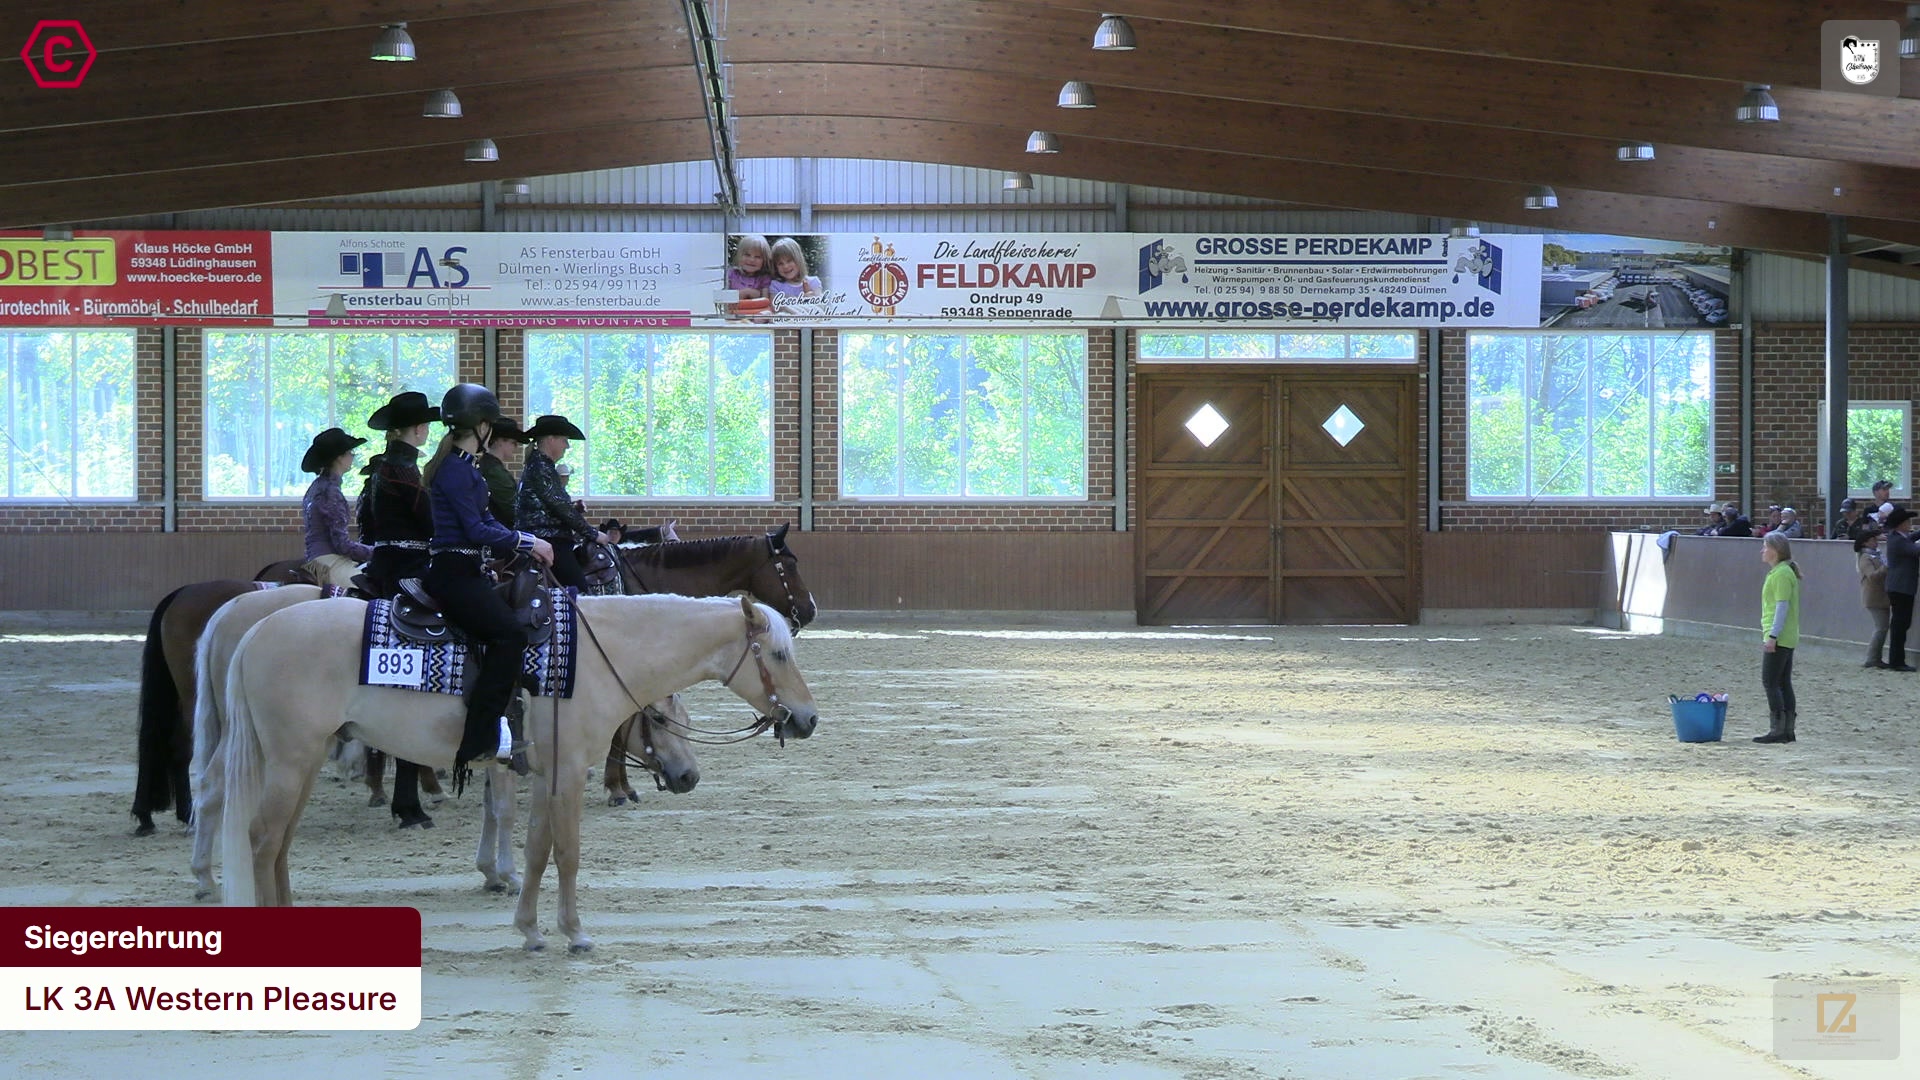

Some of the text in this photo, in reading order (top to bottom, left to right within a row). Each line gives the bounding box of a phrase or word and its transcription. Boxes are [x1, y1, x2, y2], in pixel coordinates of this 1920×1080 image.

[134, 242, 252, 254] Klaus Höcke GmbH
[339, 239, 405, 248] Alfons Schotte
[1195, 237, 1432, 256] GROSSE PERDEKAMP
[520, 247, 661, 259] AS Fensterbau GmbH
[934, 239, 1081, 265] Die Landfleischerei
[130, 258, 256, 272] 59348 Lüdinghausen
[406, 246, 470, 288] AS
[499, 262, 682, 278] Dülmen Wierlings Busch 3
[1194, 266, 1229, 275] Heizung
[1236, 266, 1266, 274] Sanitär
[1273, 266, 1324, 274] Brunnenbau
[1361, 267, 1448, 275] Erdwärmebohrungen
[127, 272, 262, 283] www.hoecke-buero.de
[917, 263, 1097, 289] FELDKAMP
[1212, 275, 1275, 284] Wärmepumpen
[1315, 276, 1430, 285] Gasfeuerungskundendienst
[860, 280, 908, 306] FELDKAMP
[1194, 286, 1211, 294] Tel.
[1300, 286, 1356, 296] Dernekamp
[1358, 286, 1370, 294] 35
[1378, 286, 1407, 294] 48249
[1410, 286, 1447, 294] Dülmen
[426, 294, 470, 306] GmbH
[521, 295, 661, 307] www.as-fensterbau.de
[773, 291, 846, 311] Geschmack ist
[970, 293, 1043, 306] Ondrup 49
[173, 299, 259, 315] Schulbedarf
[941, 307, 1073, 318] 59348 Seppenrade
[1145, 297, 1495, 322] www.grosse-perdekamp.de
[377, 652, 414, 675] 893
